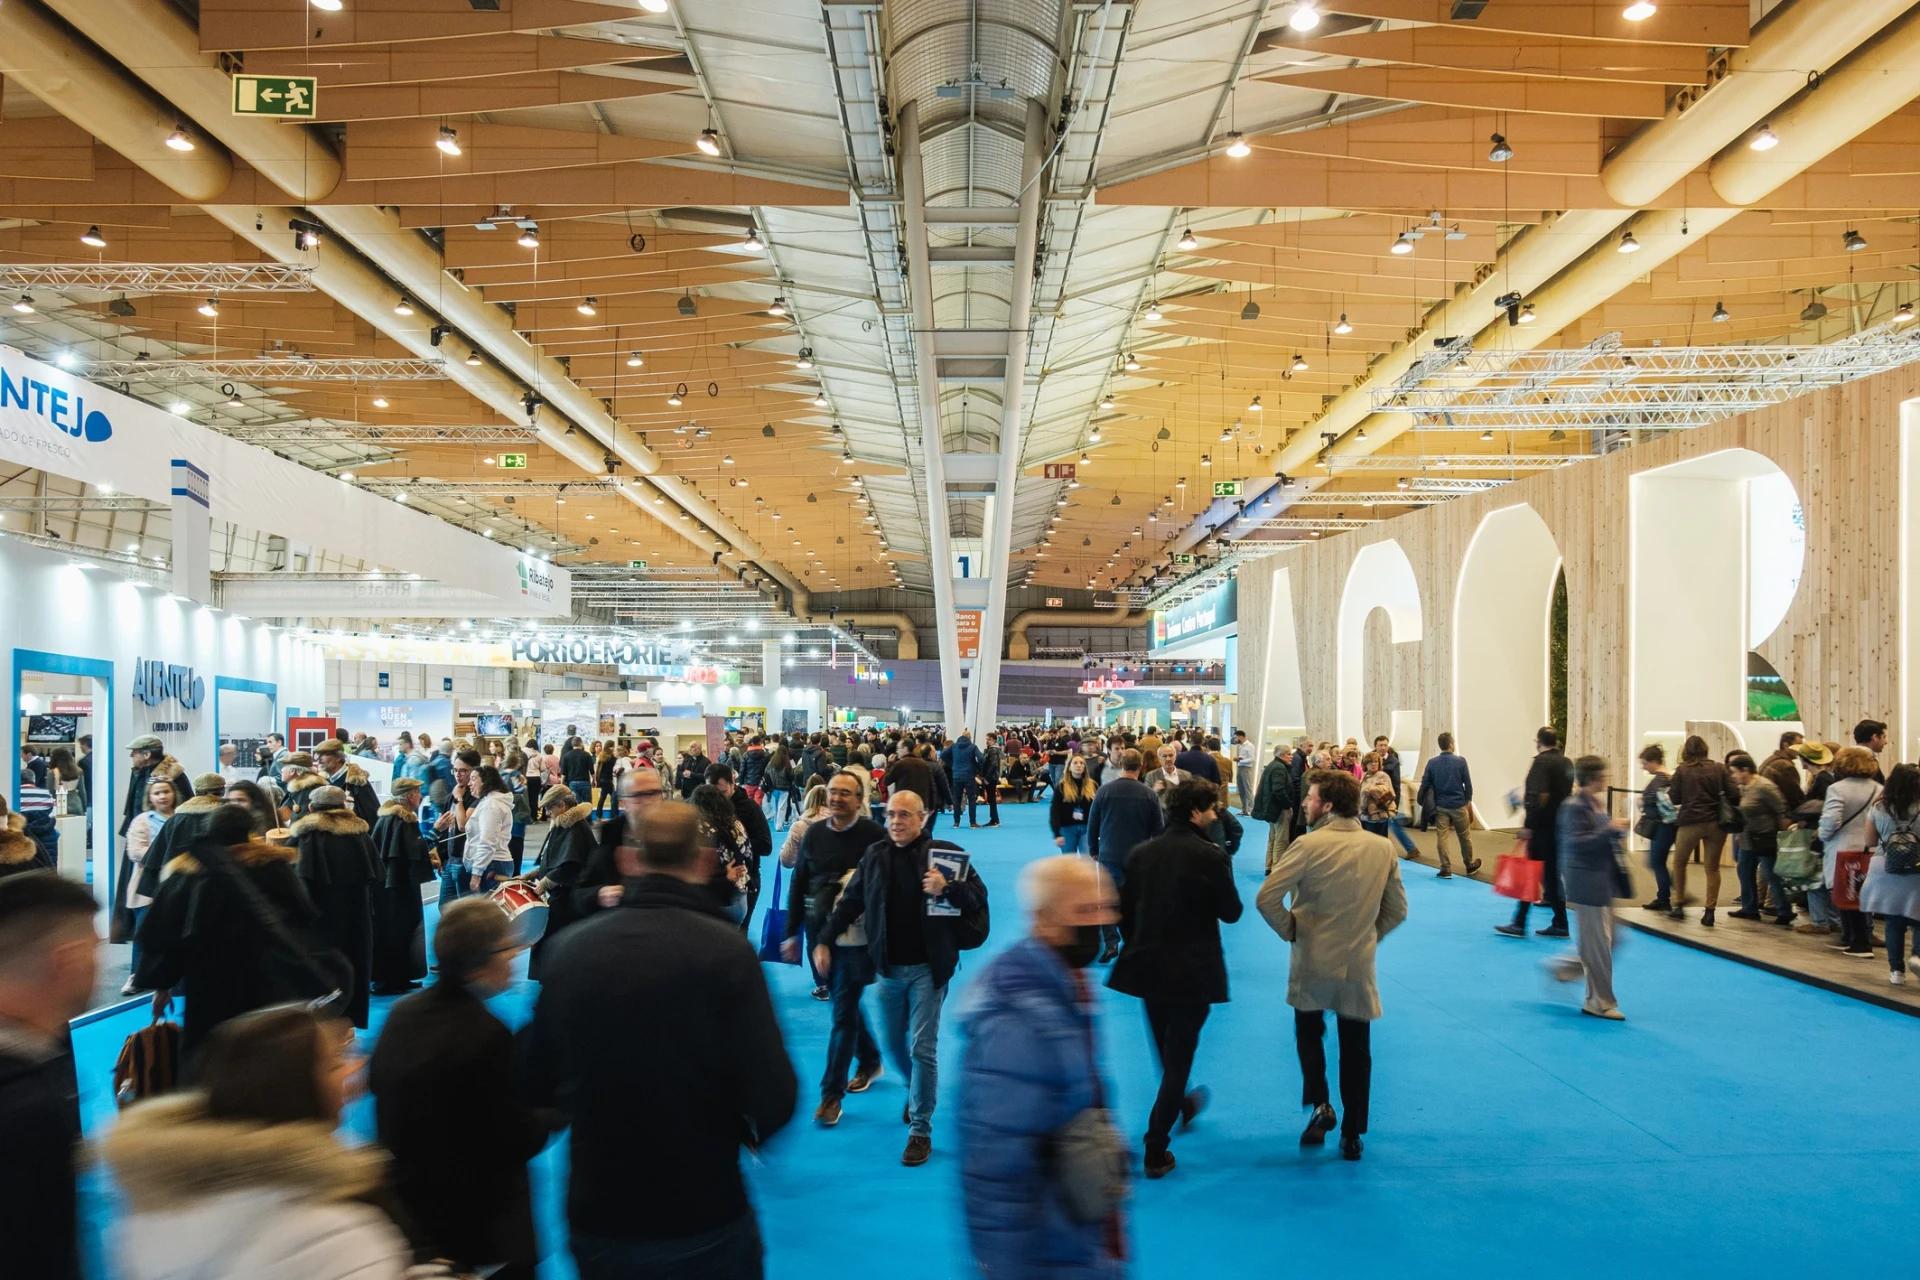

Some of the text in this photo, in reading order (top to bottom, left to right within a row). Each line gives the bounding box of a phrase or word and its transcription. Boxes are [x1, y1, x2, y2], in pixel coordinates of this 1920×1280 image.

[36, 438, 72, 459] FRESCO
[528, 567, 555, 592] Ribatejo
[958, 556, 969, 579] 1
[1196, 602, 1217, 631] Portugal
